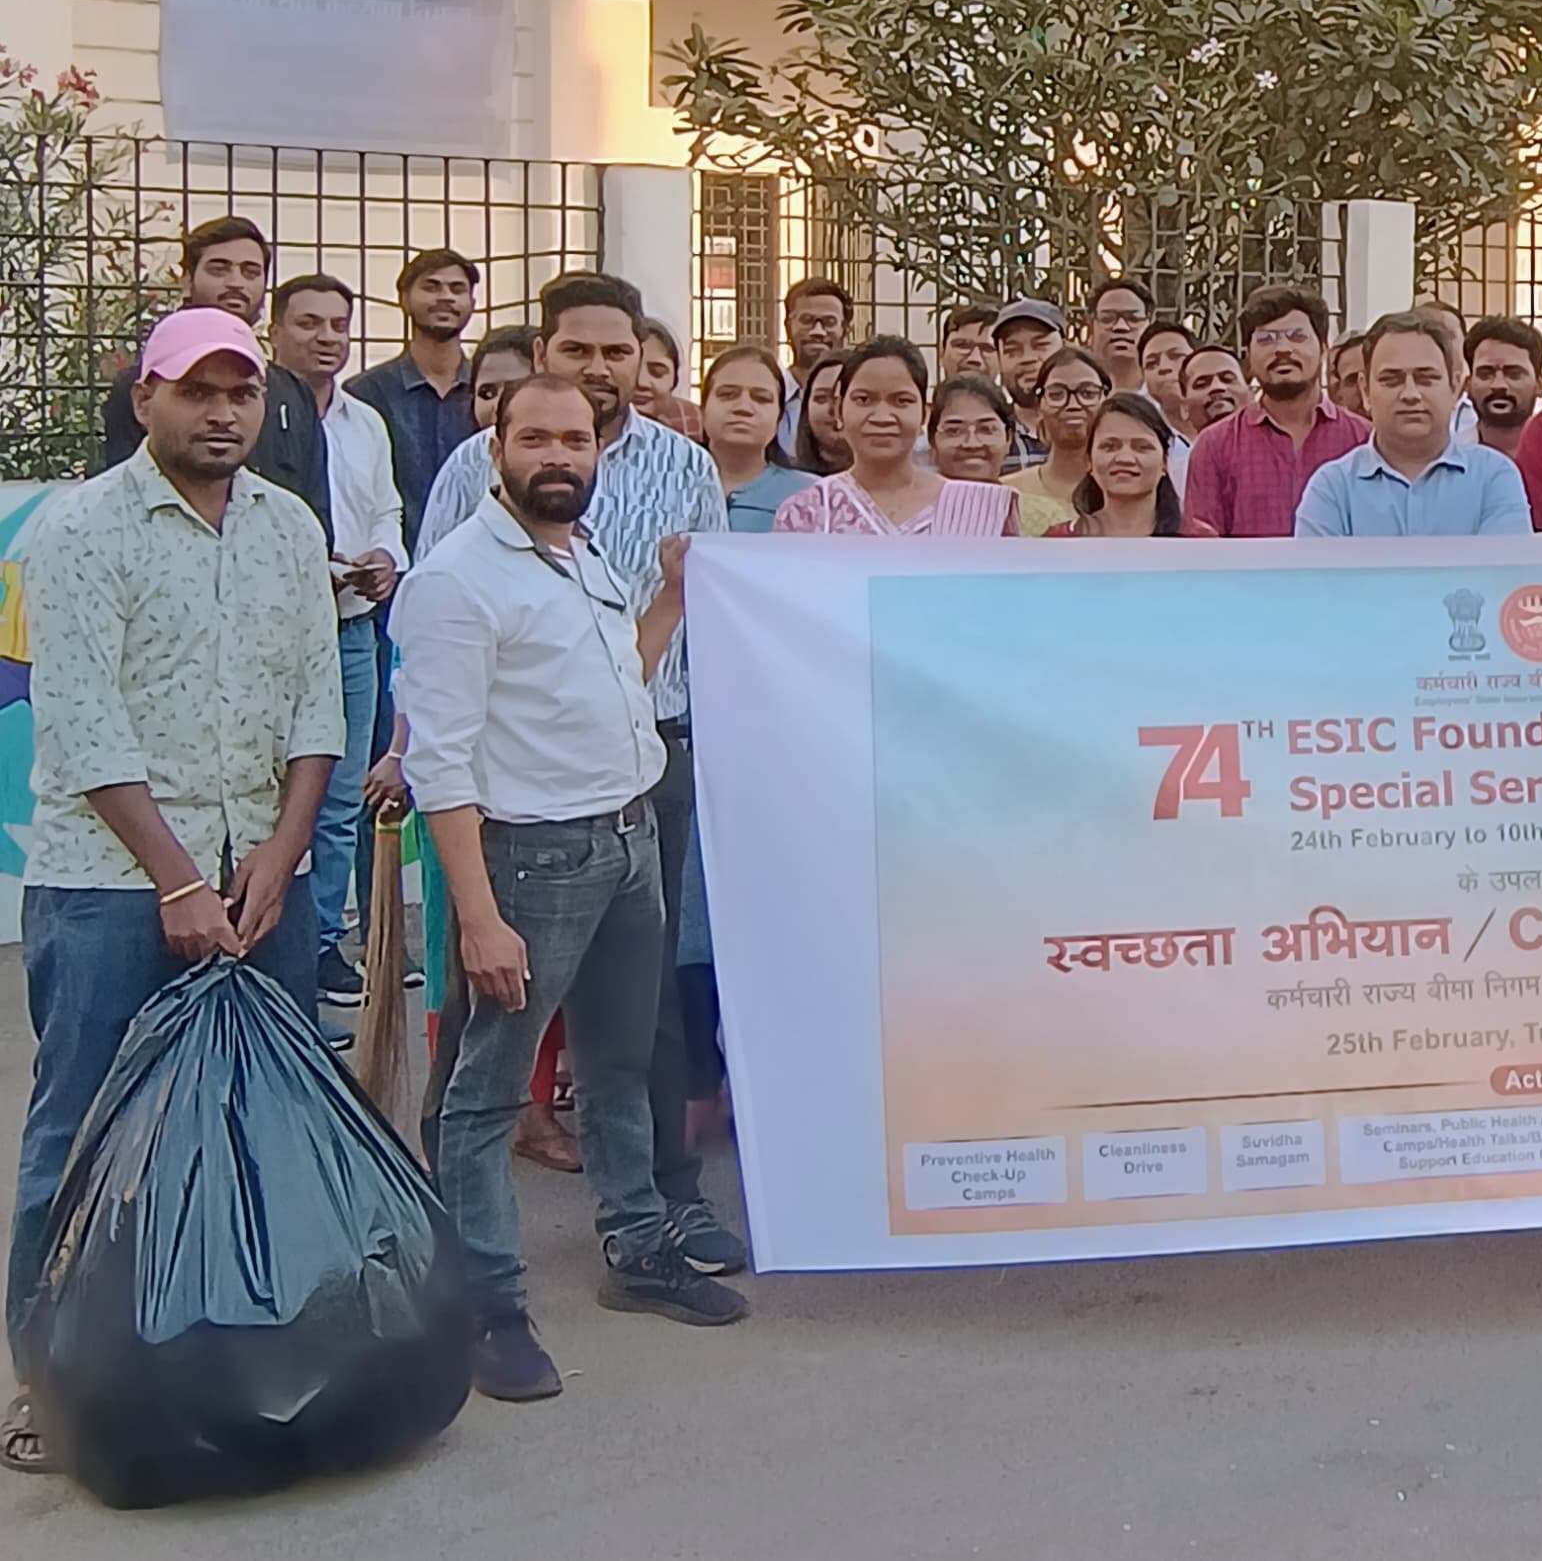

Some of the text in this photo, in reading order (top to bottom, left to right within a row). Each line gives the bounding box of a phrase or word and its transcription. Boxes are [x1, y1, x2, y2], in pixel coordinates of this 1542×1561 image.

[1416, 670, 1478, 692] कर्मचारी
[1486, 673, 1521, 689] राज्य
[1287, 716, 1397, 755] ESIC
[1289, 770, 1454, 820] Special
[1290, 829, 1342, 851] 24th
[1350, 827, 1456, 851] February
[1465, 826, 1488, 846] to
[1457, 864, 1479, 894] के
[1044, 926, 1236, 974] स्वच्छता
[1261, 905, 1453, 963] अभियान
[1266, 978, 1352, 1011] कर्मचारी
[1362, 980, 1416, 1007] राज्य
[1326, 1032, 1384, 1056] 25th
[1440, 1115, 1486, 1132] Public
[1490, 1111, 1537, 1128] Health
[1099, 1140, 1187, 1159] Cleanliness
[1241, 1133, 1303, 1150] Suvidha
[920, 1147, 1056, 1167] Preventive Health
[1123, 1159, 1164, 1175] Drive
[1235, 1150, 1310, 1169] Samagam
[1399, 1154, 1457, 1171] Support
[1461, 1147, 1535, 1167] Education
[951, 1168, 1026, 1186] Check-Up
[962, 1185, 1016, 1203] Camps
